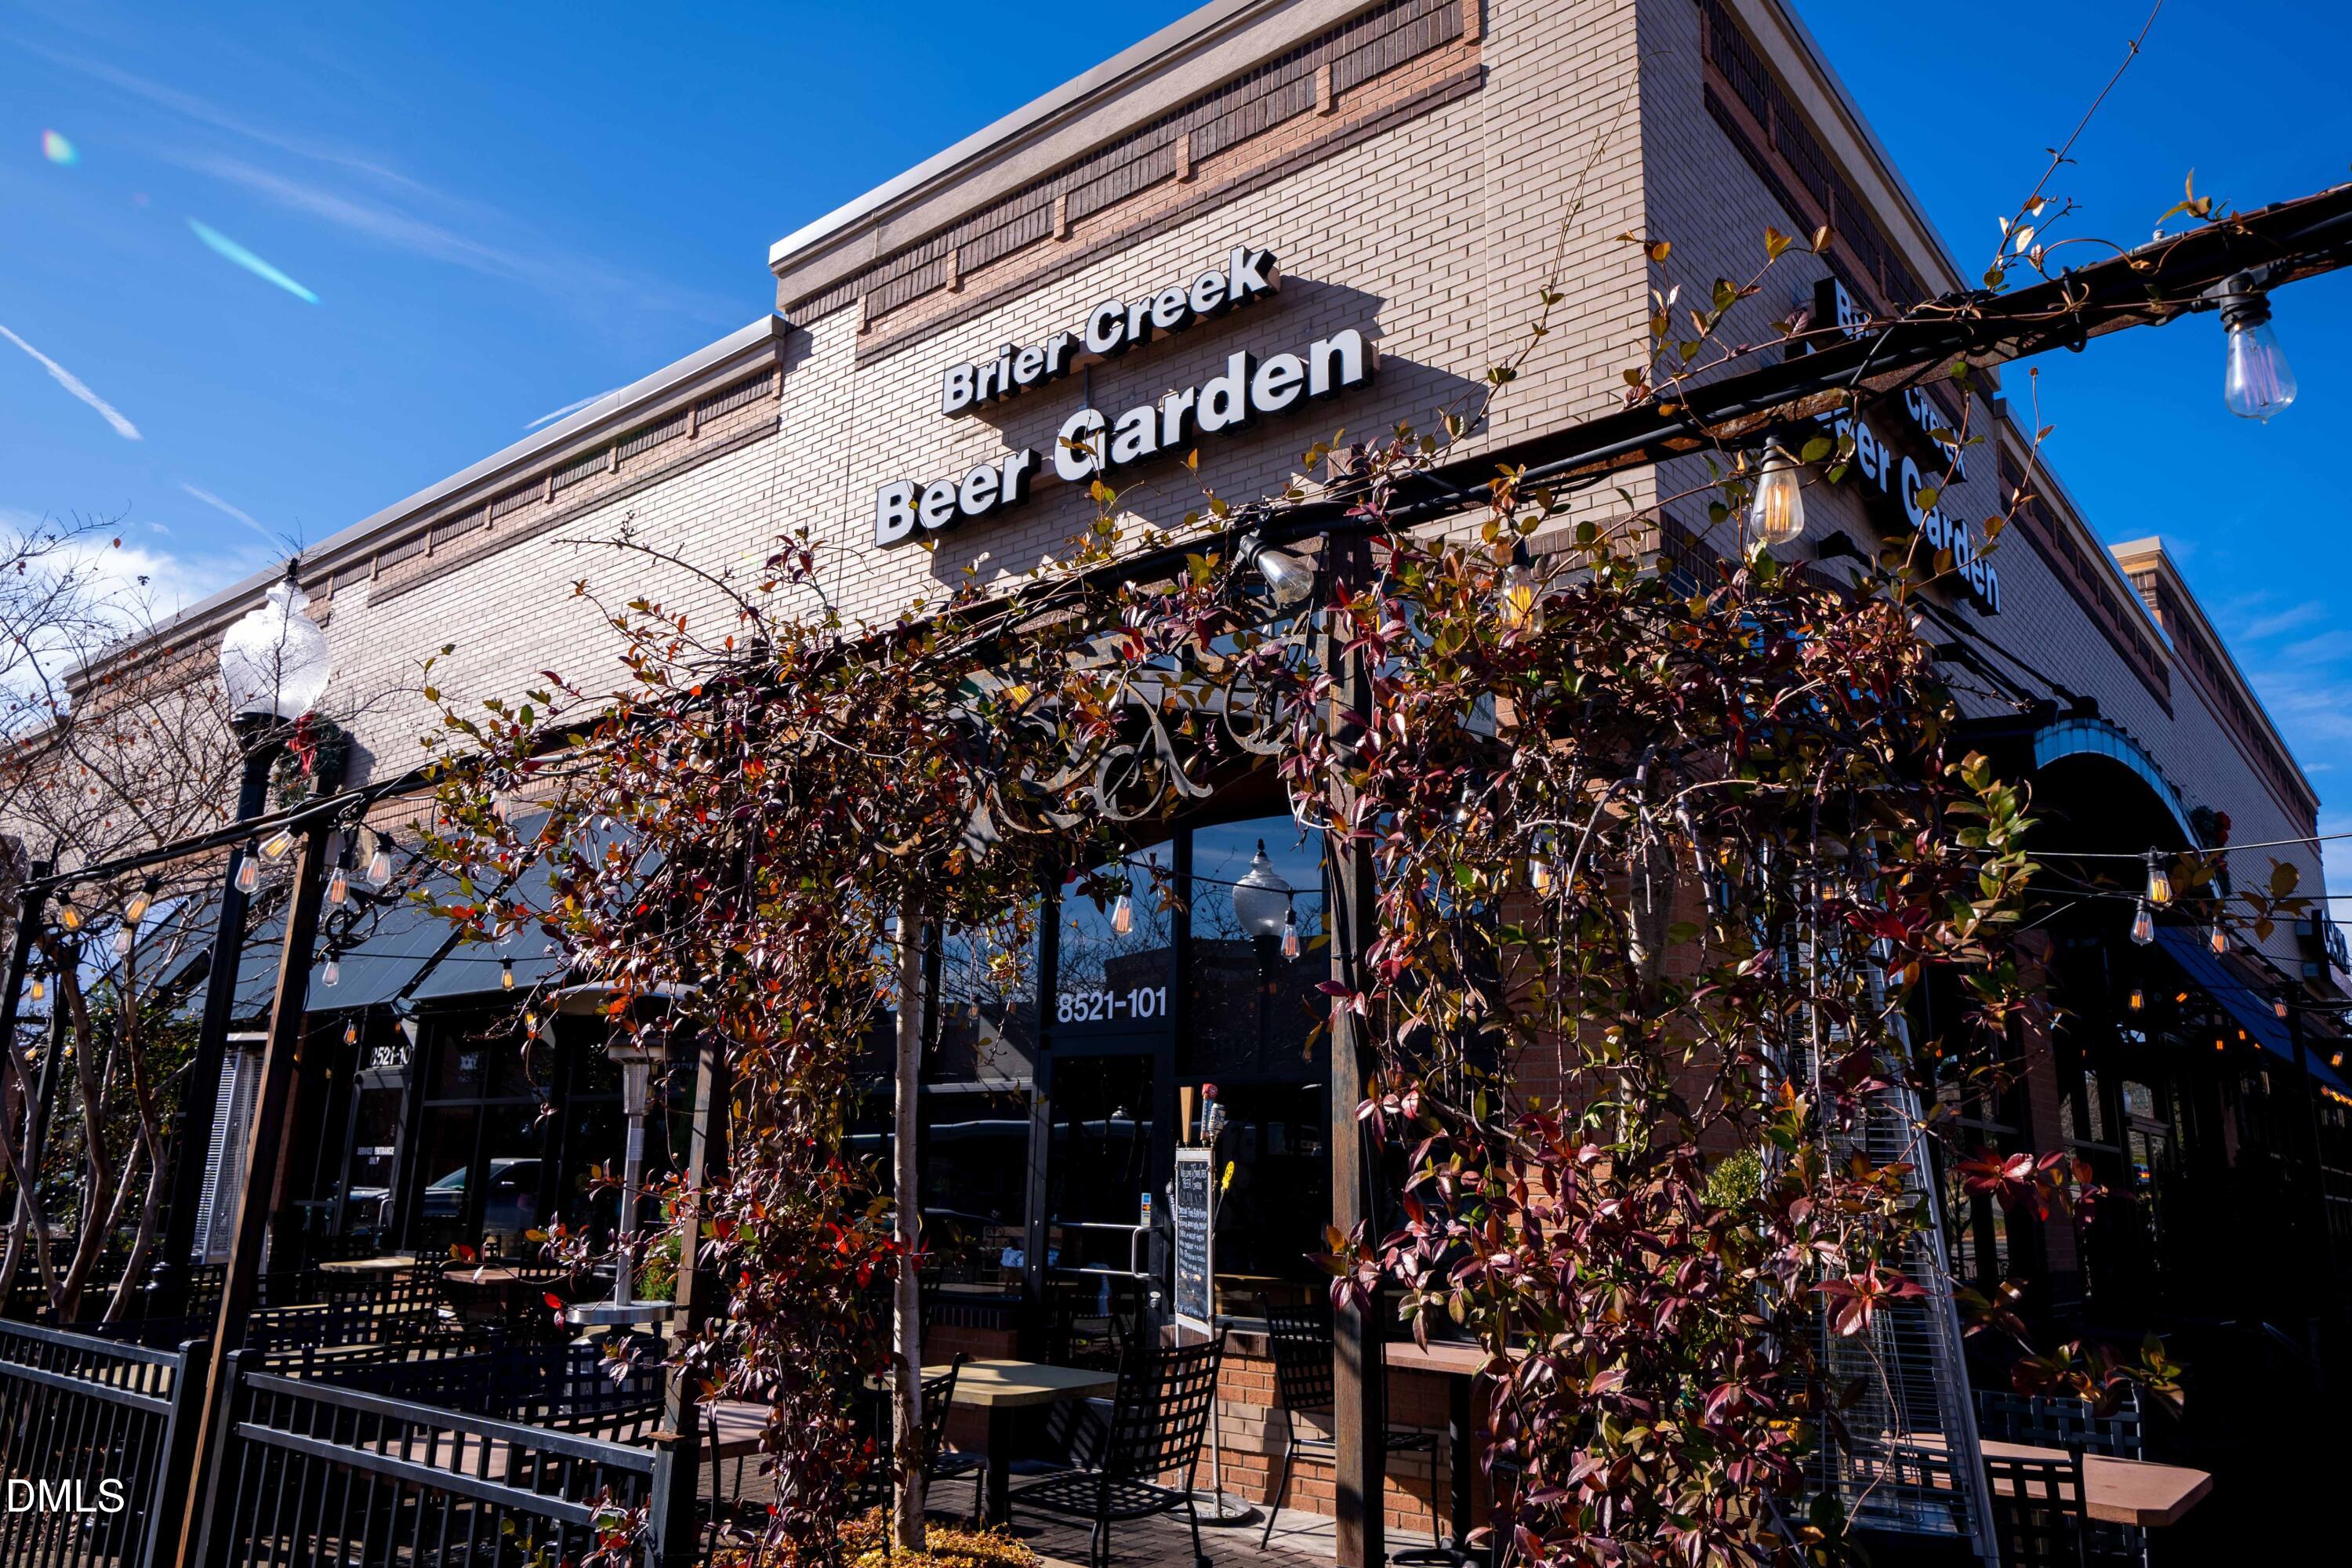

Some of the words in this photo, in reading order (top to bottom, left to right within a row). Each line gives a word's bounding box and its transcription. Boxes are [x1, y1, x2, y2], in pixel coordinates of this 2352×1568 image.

[942, 331, 1069, 416] Brier
[1085, 245, 1269, 353] Creek
[875, 448, 1031, 547] Beer
[1052, 328, 1364, 482] Garden
[1900, 455, 2001, 615] Garden
[370, 1045, 414, 1065] 8521-10
[1058, 986, 1166, 1023] 8521-101
